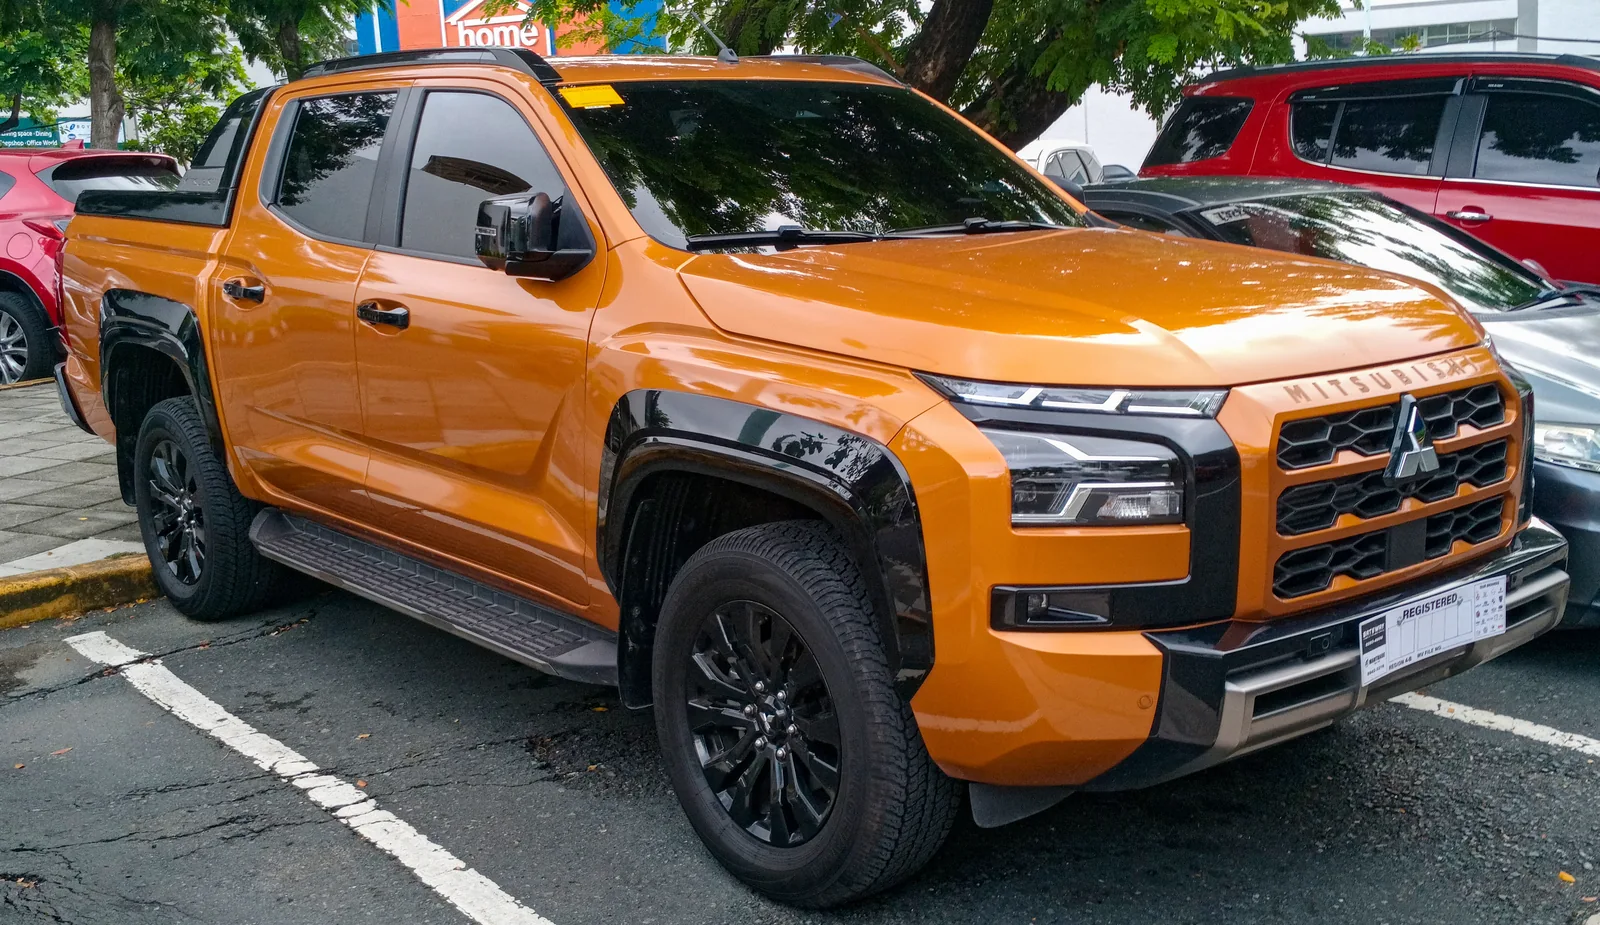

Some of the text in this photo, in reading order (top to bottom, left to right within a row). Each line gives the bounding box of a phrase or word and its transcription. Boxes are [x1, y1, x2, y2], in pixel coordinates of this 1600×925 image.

[457, 20, 538, 47] home
[35, 130, 52, 138] Dining
[1283, 354, 1480, 404] MITSUBISHI
[1402, 592, 1458, 620] REGISTERED
[1388, 659, 1405, 671] REGION
